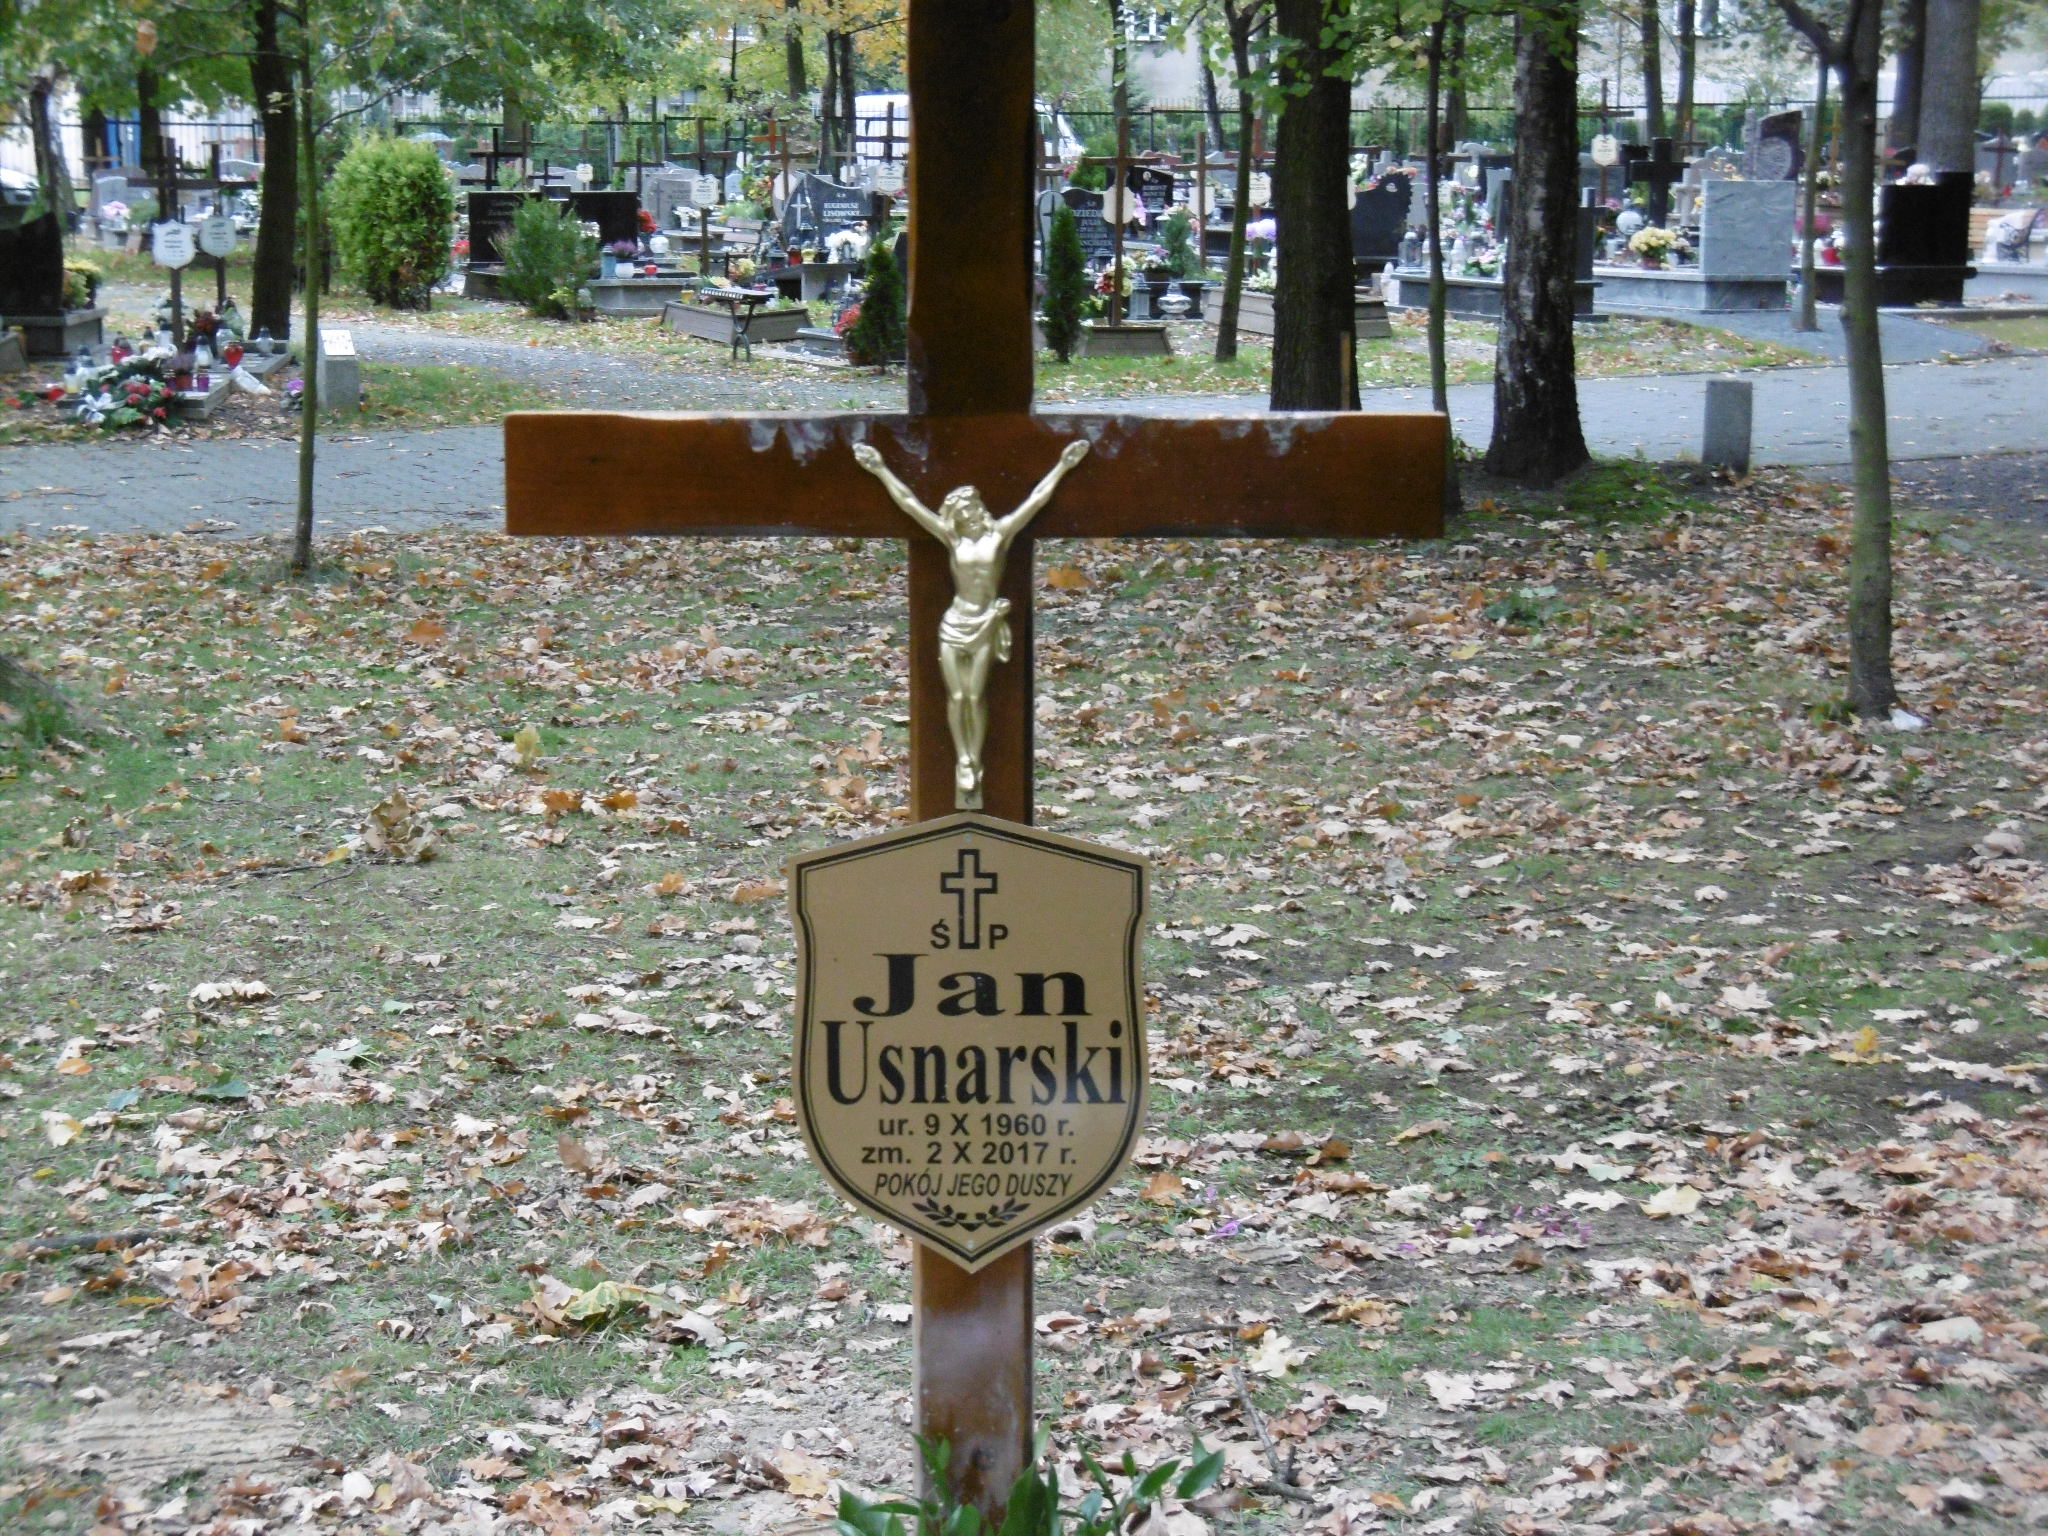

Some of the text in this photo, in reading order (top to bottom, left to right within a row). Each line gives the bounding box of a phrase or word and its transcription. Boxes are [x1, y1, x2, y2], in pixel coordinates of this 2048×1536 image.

[988, 923, 1009, 950] P
[852, 953, 1093, 1017] Jan
[819, 1019, 1127, 1105] Usnarski
[878, 1113, 1075, 1137] ur. 9 X 1960 r.
[861, 1141, 1077, 1165] zm. 2 X 2017 r.
[874, 1168, 1073, 1197] POKÓJ JEGO DUSZY
